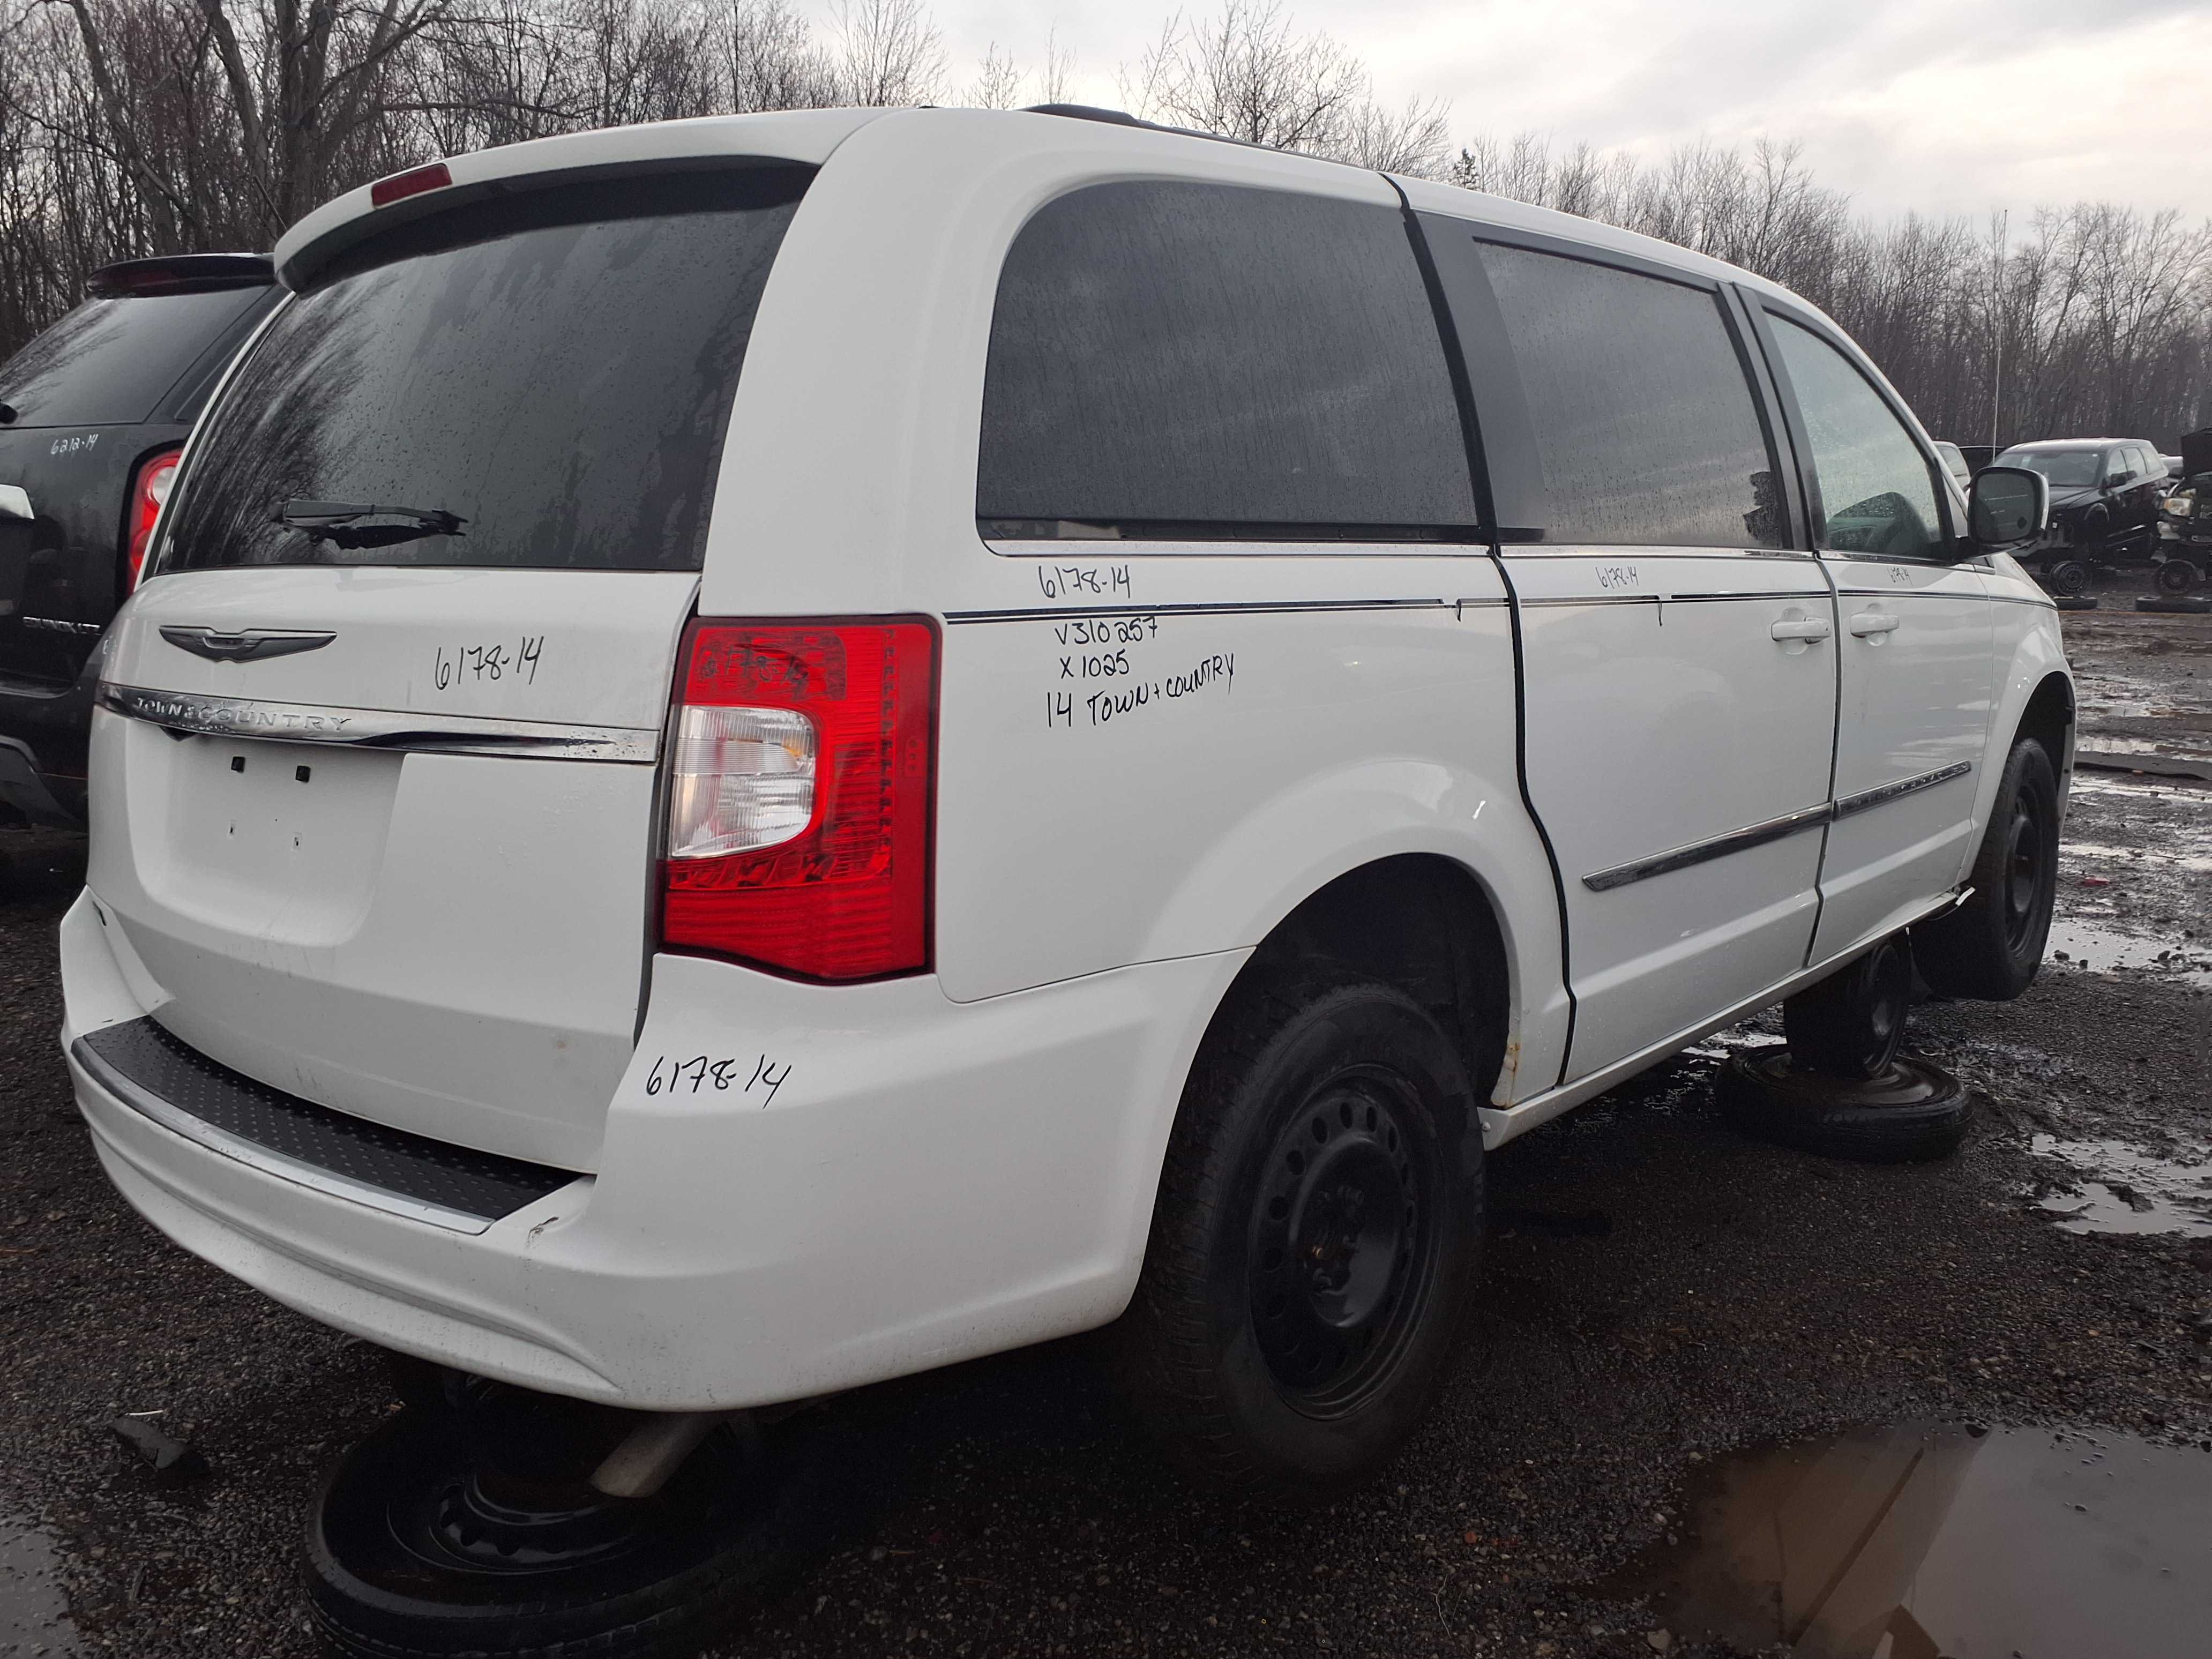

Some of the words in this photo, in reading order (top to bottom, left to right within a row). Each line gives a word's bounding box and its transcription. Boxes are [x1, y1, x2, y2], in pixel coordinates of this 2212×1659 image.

[1038, 564, 1131, 598] 6178-14
[435, 636, 544, 690] 6178-14
[1047, 691, 1072, 728] 14
